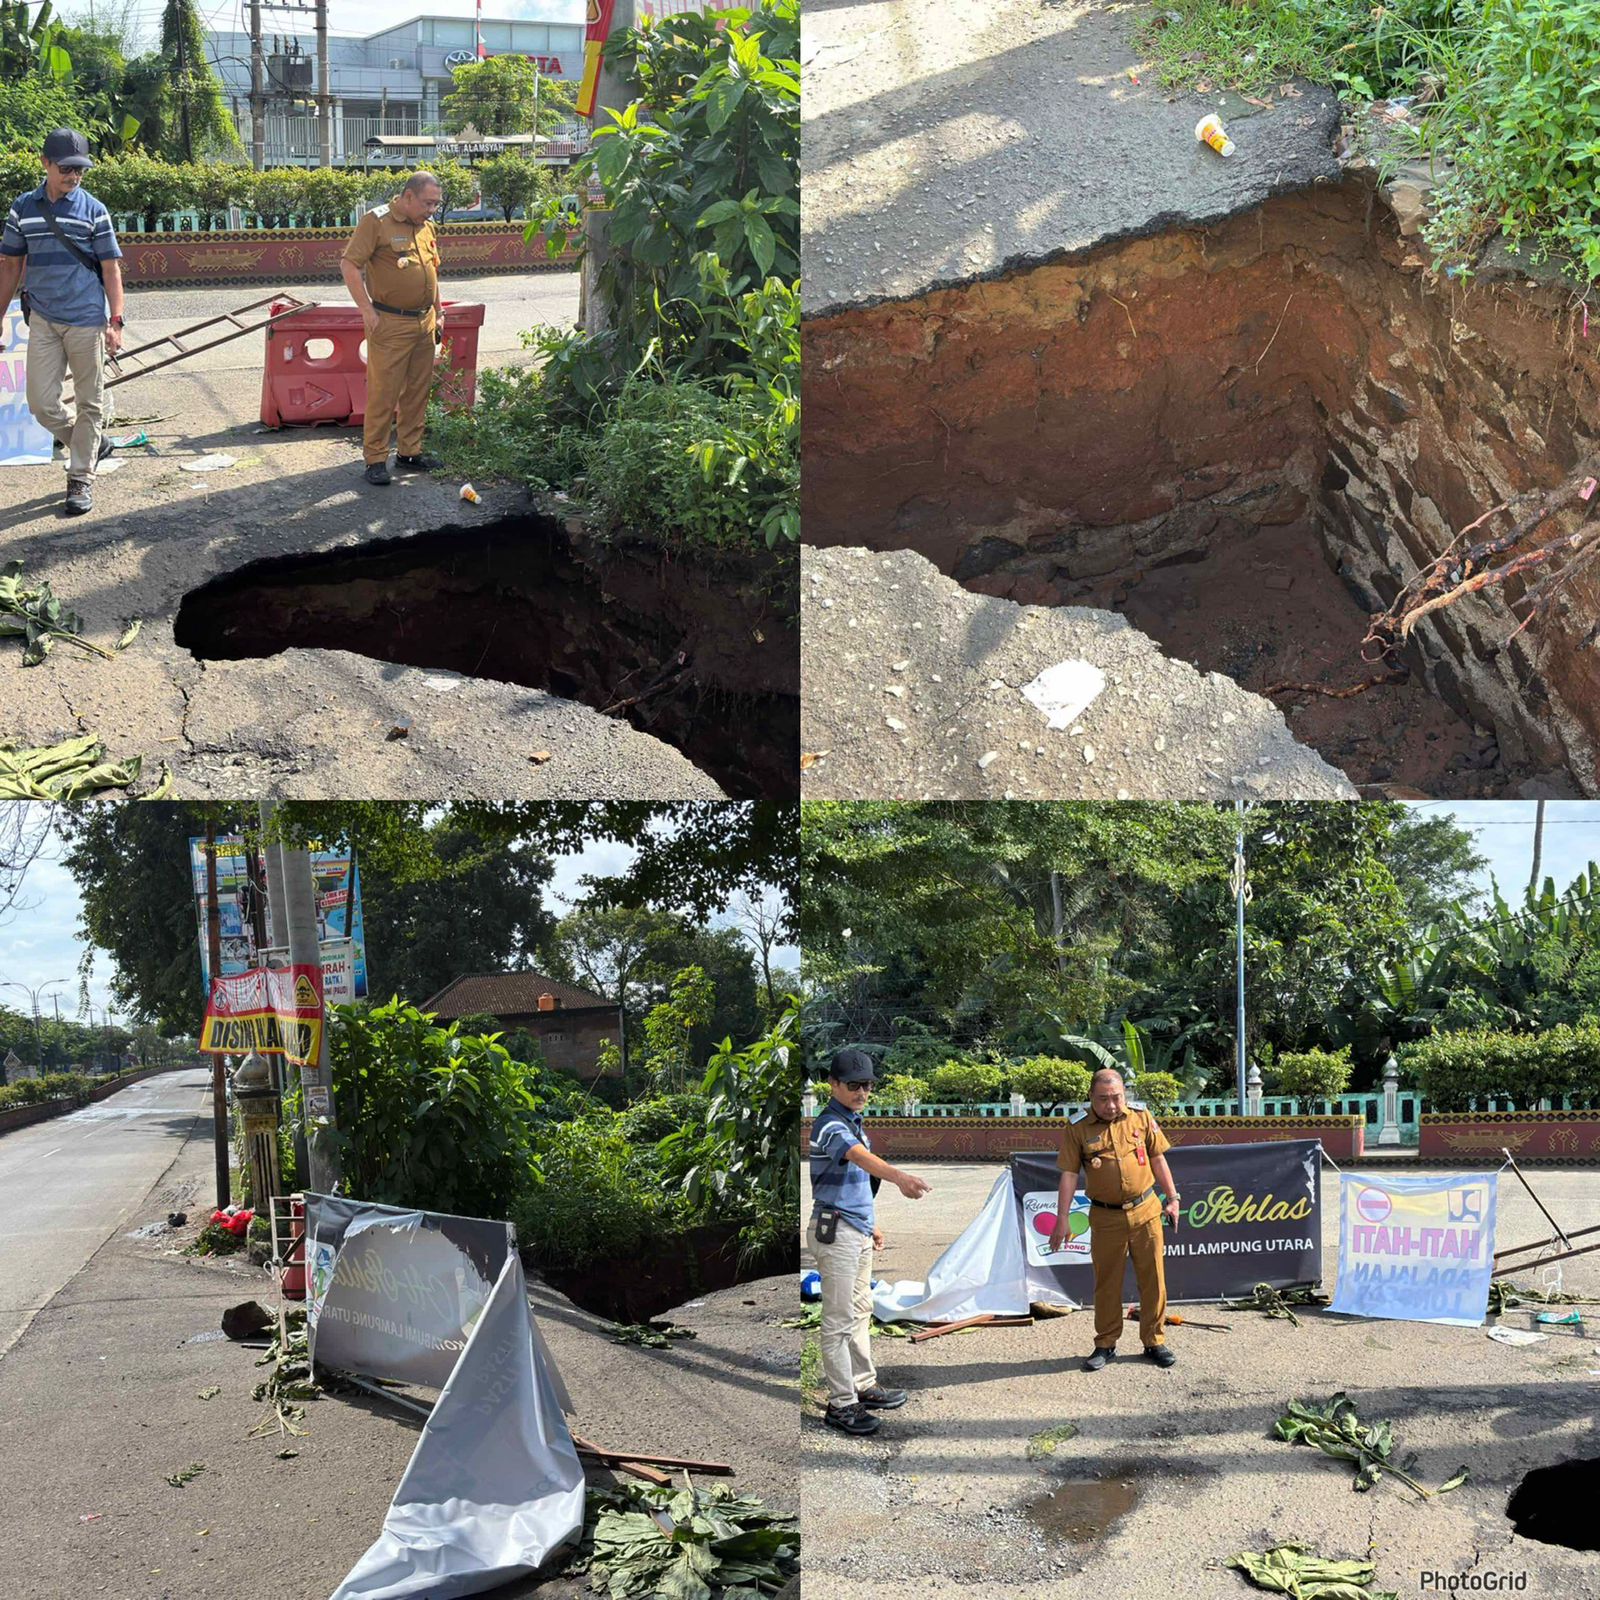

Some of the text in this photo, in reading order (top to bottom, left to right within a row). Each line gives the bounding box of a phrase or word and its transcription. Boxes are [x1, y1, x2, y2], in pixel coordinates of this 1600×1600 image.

[436, 143, 504, 152] HALTE ALAMSYAH
[1025, 1198, 1057, 1213] Ruma
[1160, 1185, 1312, 1229] -Ikhlas
[1188, 1240, 1262, 1256] LAMPUNG
[1265, 1237, 1314, 1251] UTARA
